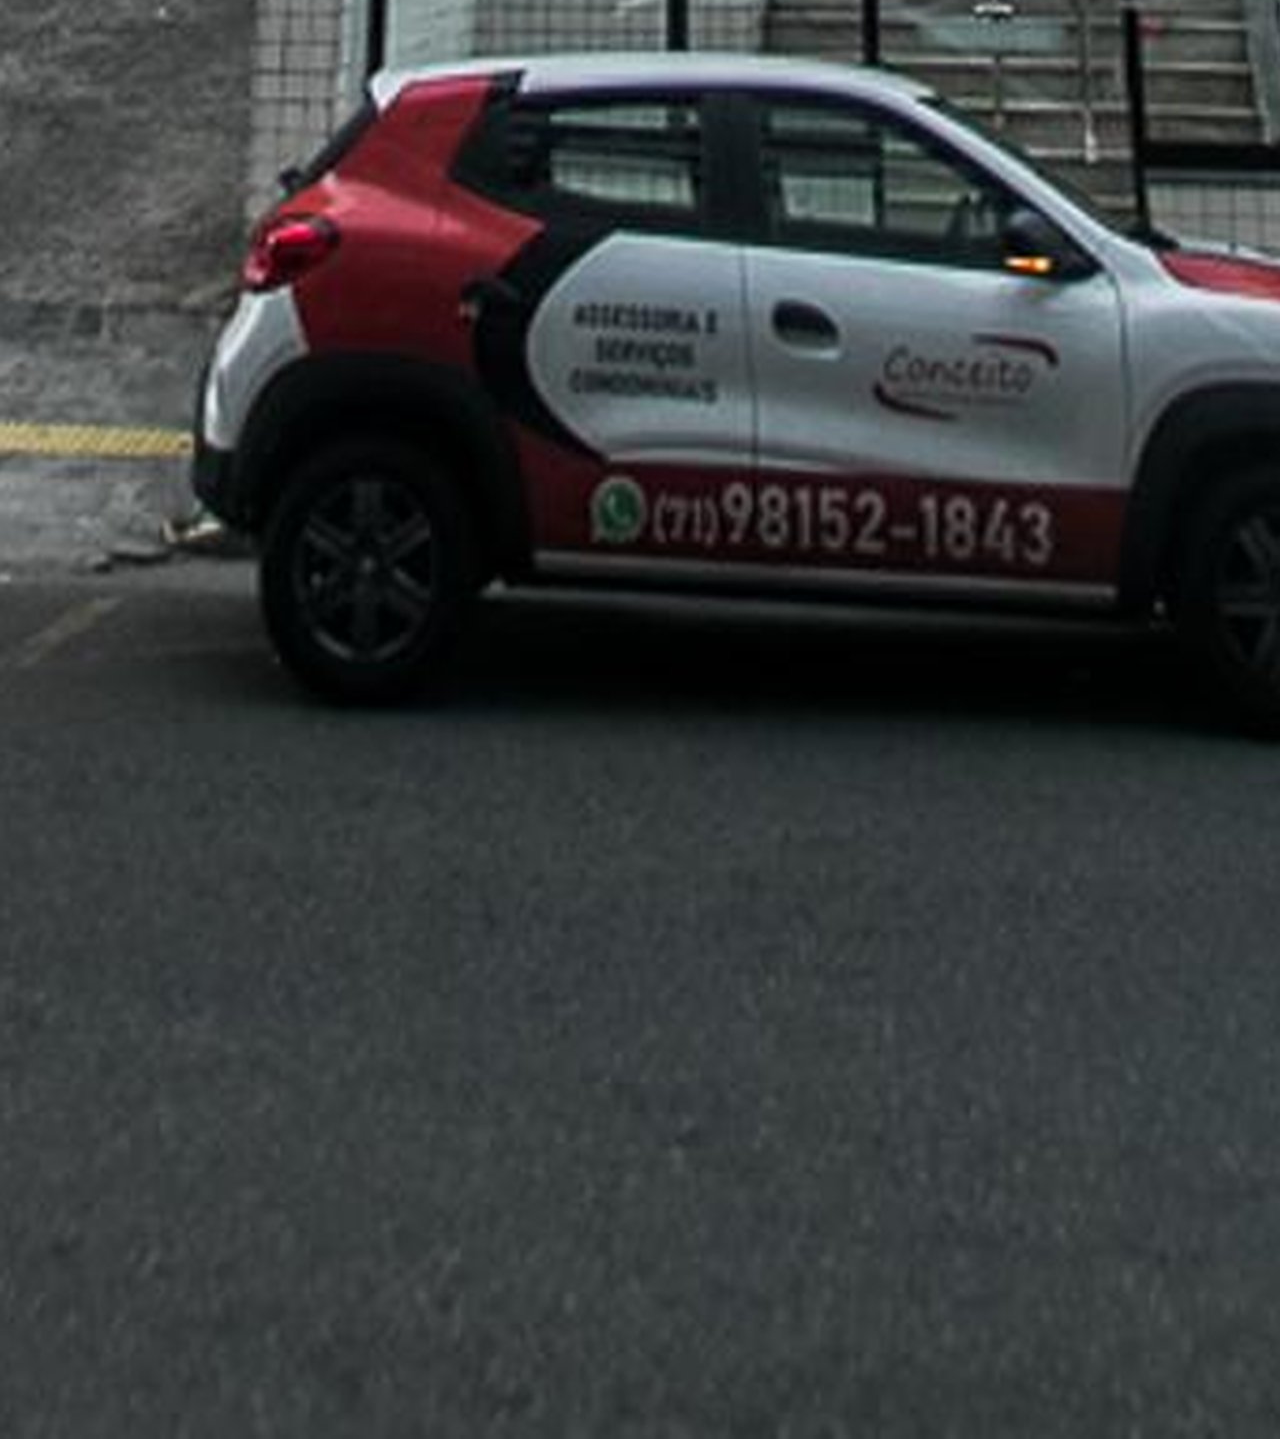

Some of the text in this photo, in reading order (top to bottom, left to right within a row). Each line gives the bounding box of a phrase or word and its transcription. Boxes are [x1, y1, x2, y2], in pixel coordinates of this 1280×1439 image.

[596, 335, 694, 371] SERVIÇOS
[883, 345, 1034, 394] Conceito
[571, 367, 718, 405] CONDOMINIAIS
[652, 481, 1053, 564] (71) 98152-1843
